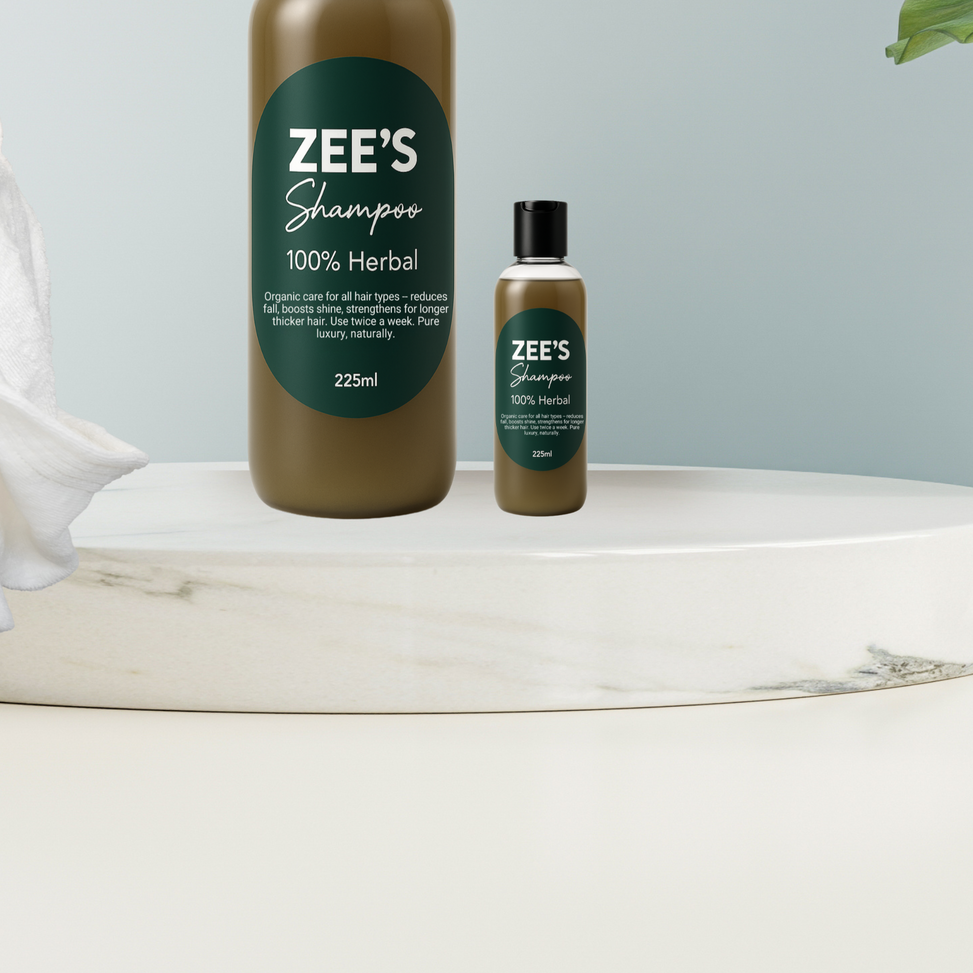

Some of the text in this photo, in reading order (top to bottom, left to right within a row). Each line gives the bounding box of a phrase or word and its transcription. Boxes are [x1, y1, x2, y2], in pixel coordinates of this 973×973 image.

[288, 127, 418, 173] ZEE’S
[285, 177, 423, 236] Shampoo
[286, 248, 418, 272] 100% Herbal
[264, 291, 301, 304] Organic
[302, 293, 324, 301] care
[325, 291, 340, 301] for
[341, 291, 352, 301] all
[354, 291, 373, 301] hair
[374, 291, 400, 304] types
[410, 291, 448, 301] reduces
[263, 304, 449, 316] fall, boosts shine, strengthens for longer
[272, 316, 440, 326] thicker hair. Use twice a week. Pure
[316, 328, 395, 341] luxury, naturally.
[511, 339, 571, 361] ZEE’S
[334, 372, 378, 388] 225ml
[509, 362, 573, 389] Shampoo
[511, 394, 571, 405] 100% Herbal
[532, 450, 553, 458] 225ml
